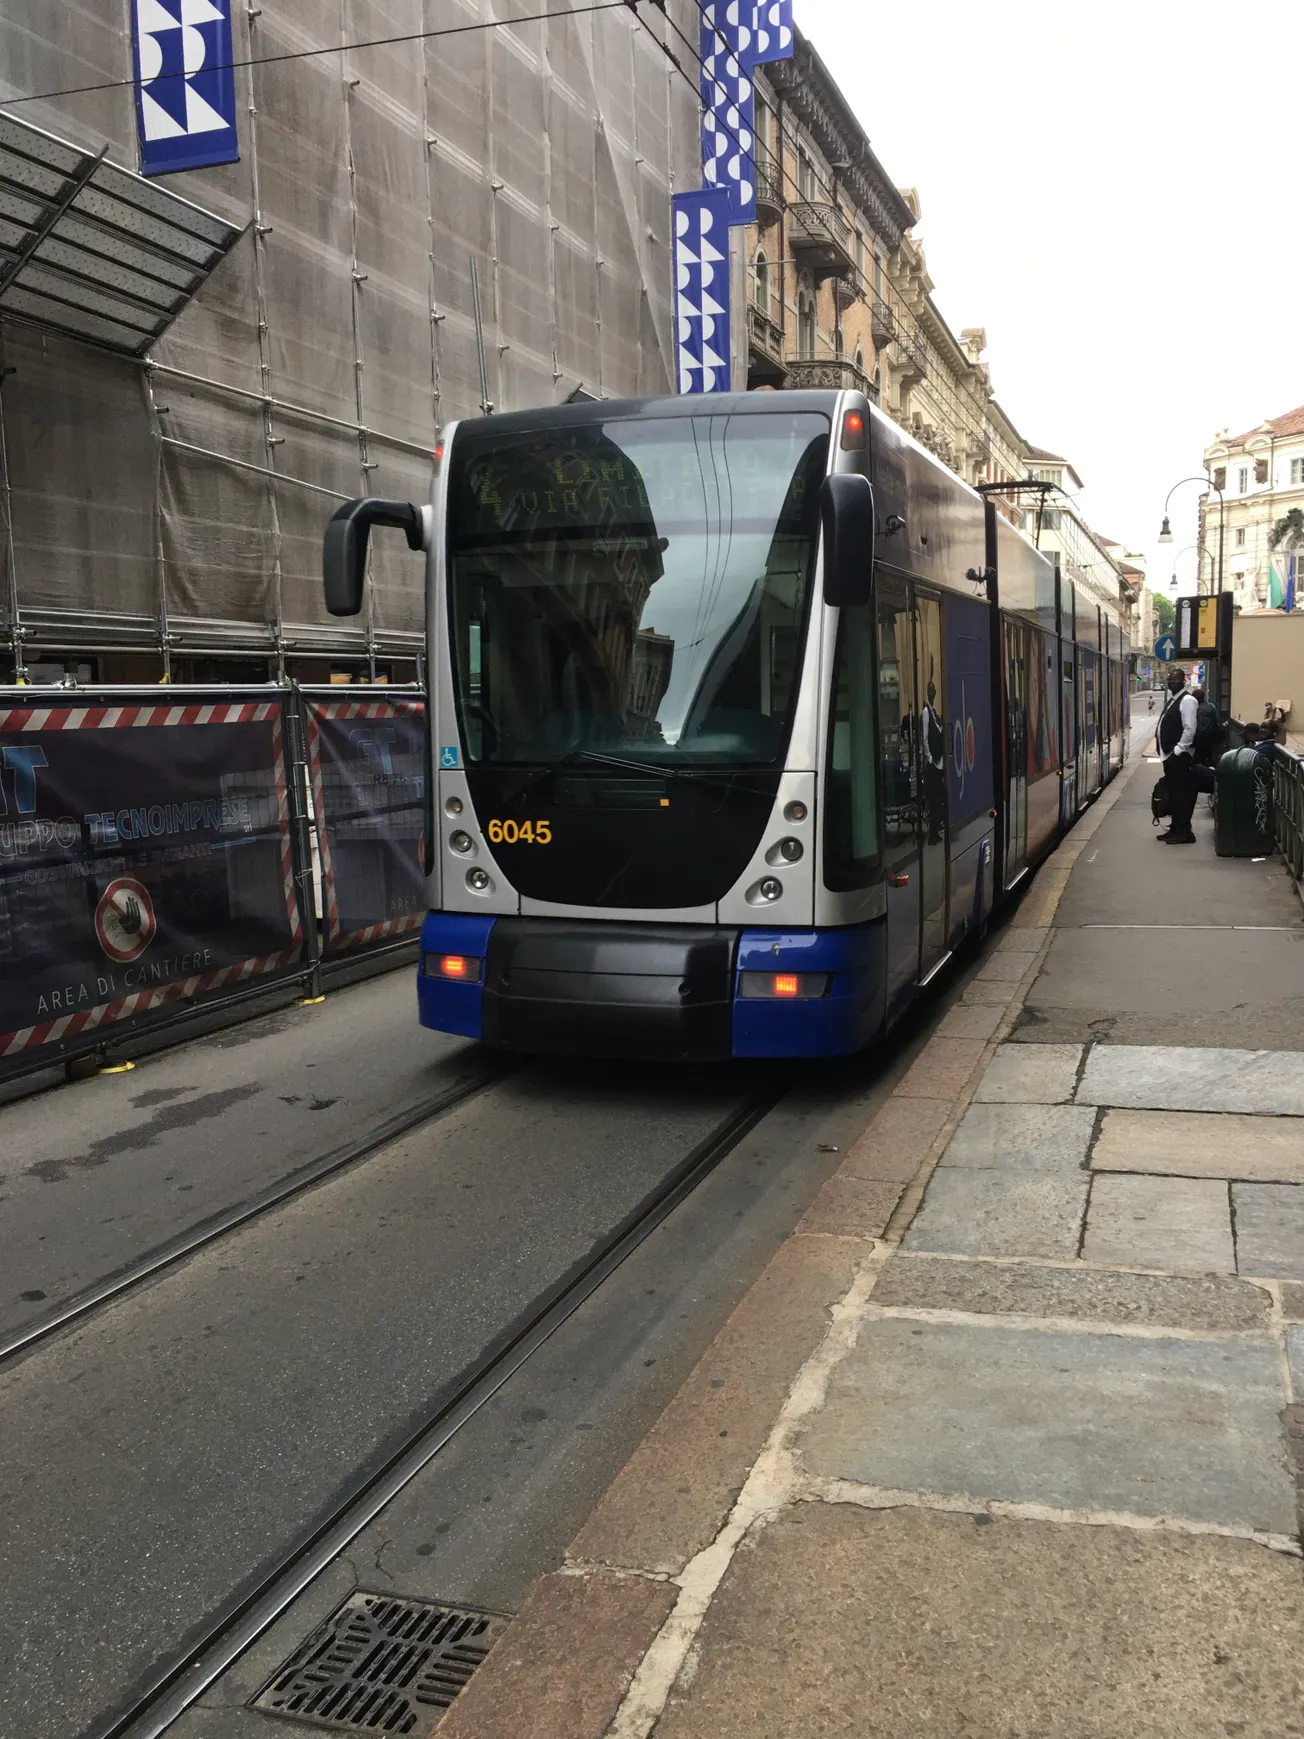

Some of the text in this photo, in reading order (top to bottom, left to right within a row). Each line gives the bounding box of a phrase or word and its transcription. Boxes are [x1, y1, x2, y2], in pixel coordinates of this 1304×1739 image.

[520, 489, 578, 514] VIA
[84, 795, 252, 845] TECNOIMPRESE
[488, 818, 552, 844] 6045
[391, 895, 418, 913] AREA
[36, 948, 212, 1014] AREA DI CANTIERE
